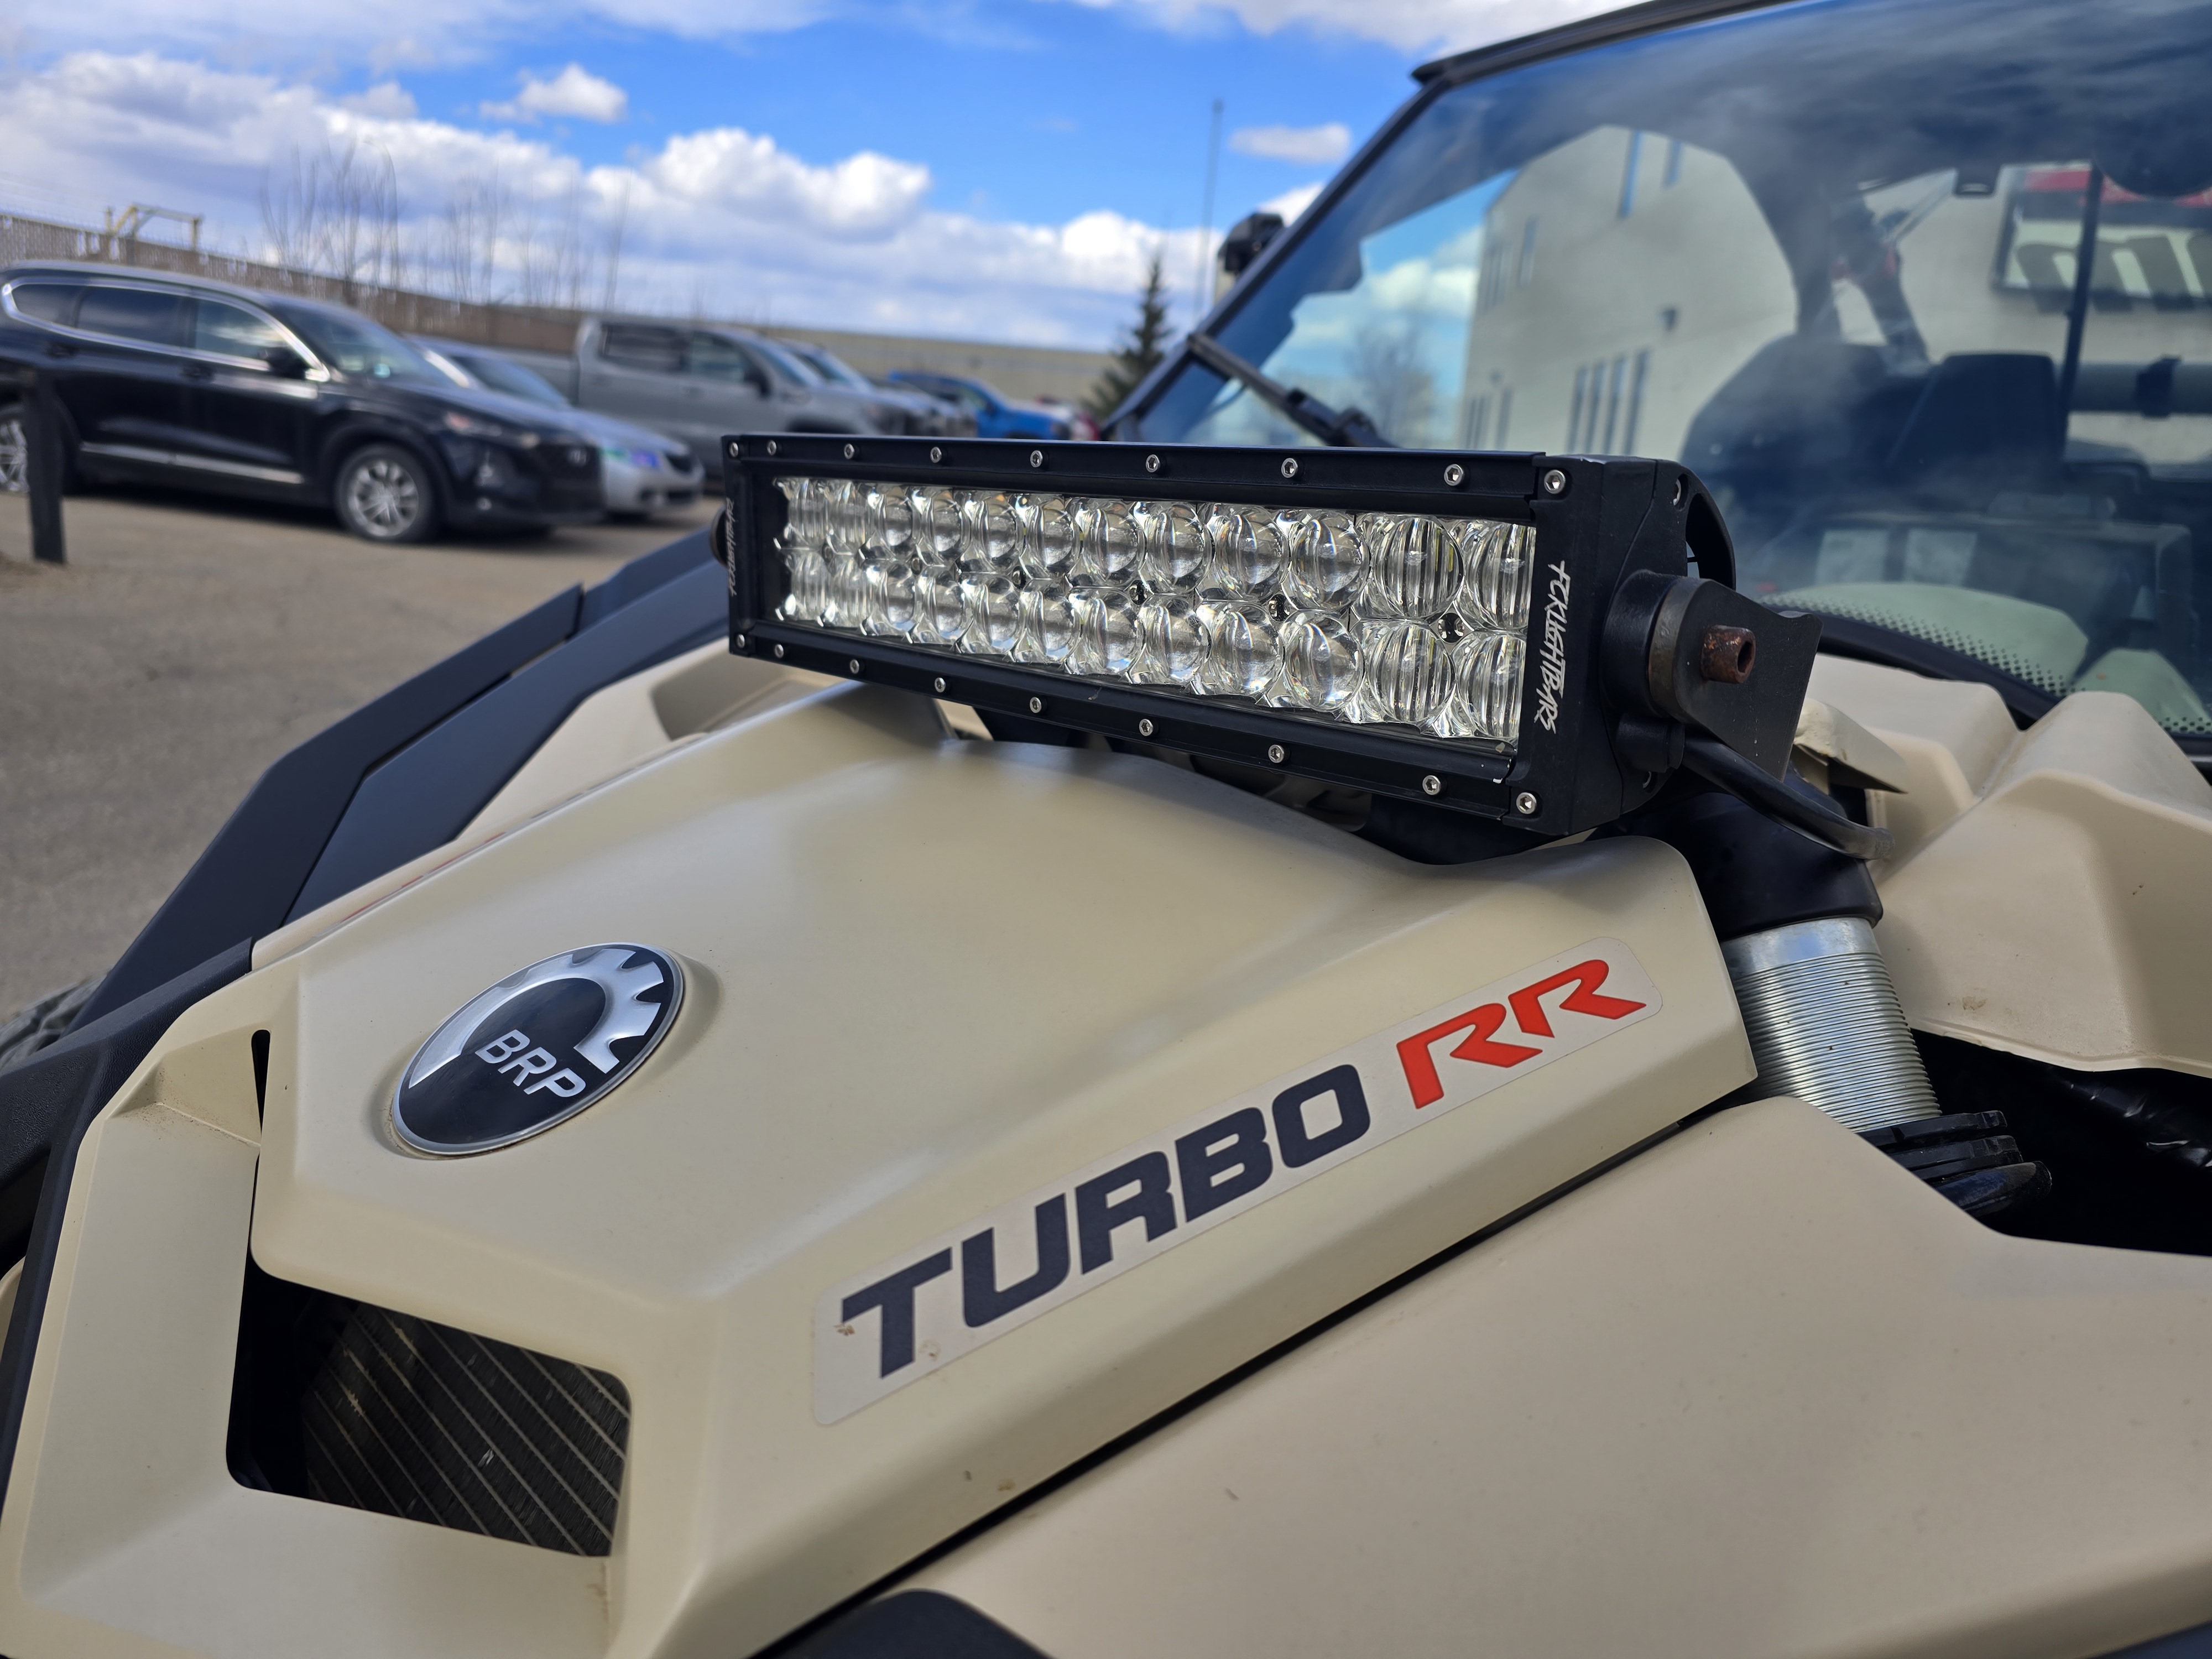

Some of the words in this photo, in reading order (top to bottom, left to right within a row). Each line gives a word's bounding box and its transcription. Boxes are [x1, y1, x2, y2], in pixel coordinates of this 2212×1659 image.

[1533, 560, 1572, 734] FCKLIGHTBARS
[474, 1029, 587, 1098] BRP
[841, 1063, 1371, 1380] TURBO
[1396, 959, 1647, 1110] RR
